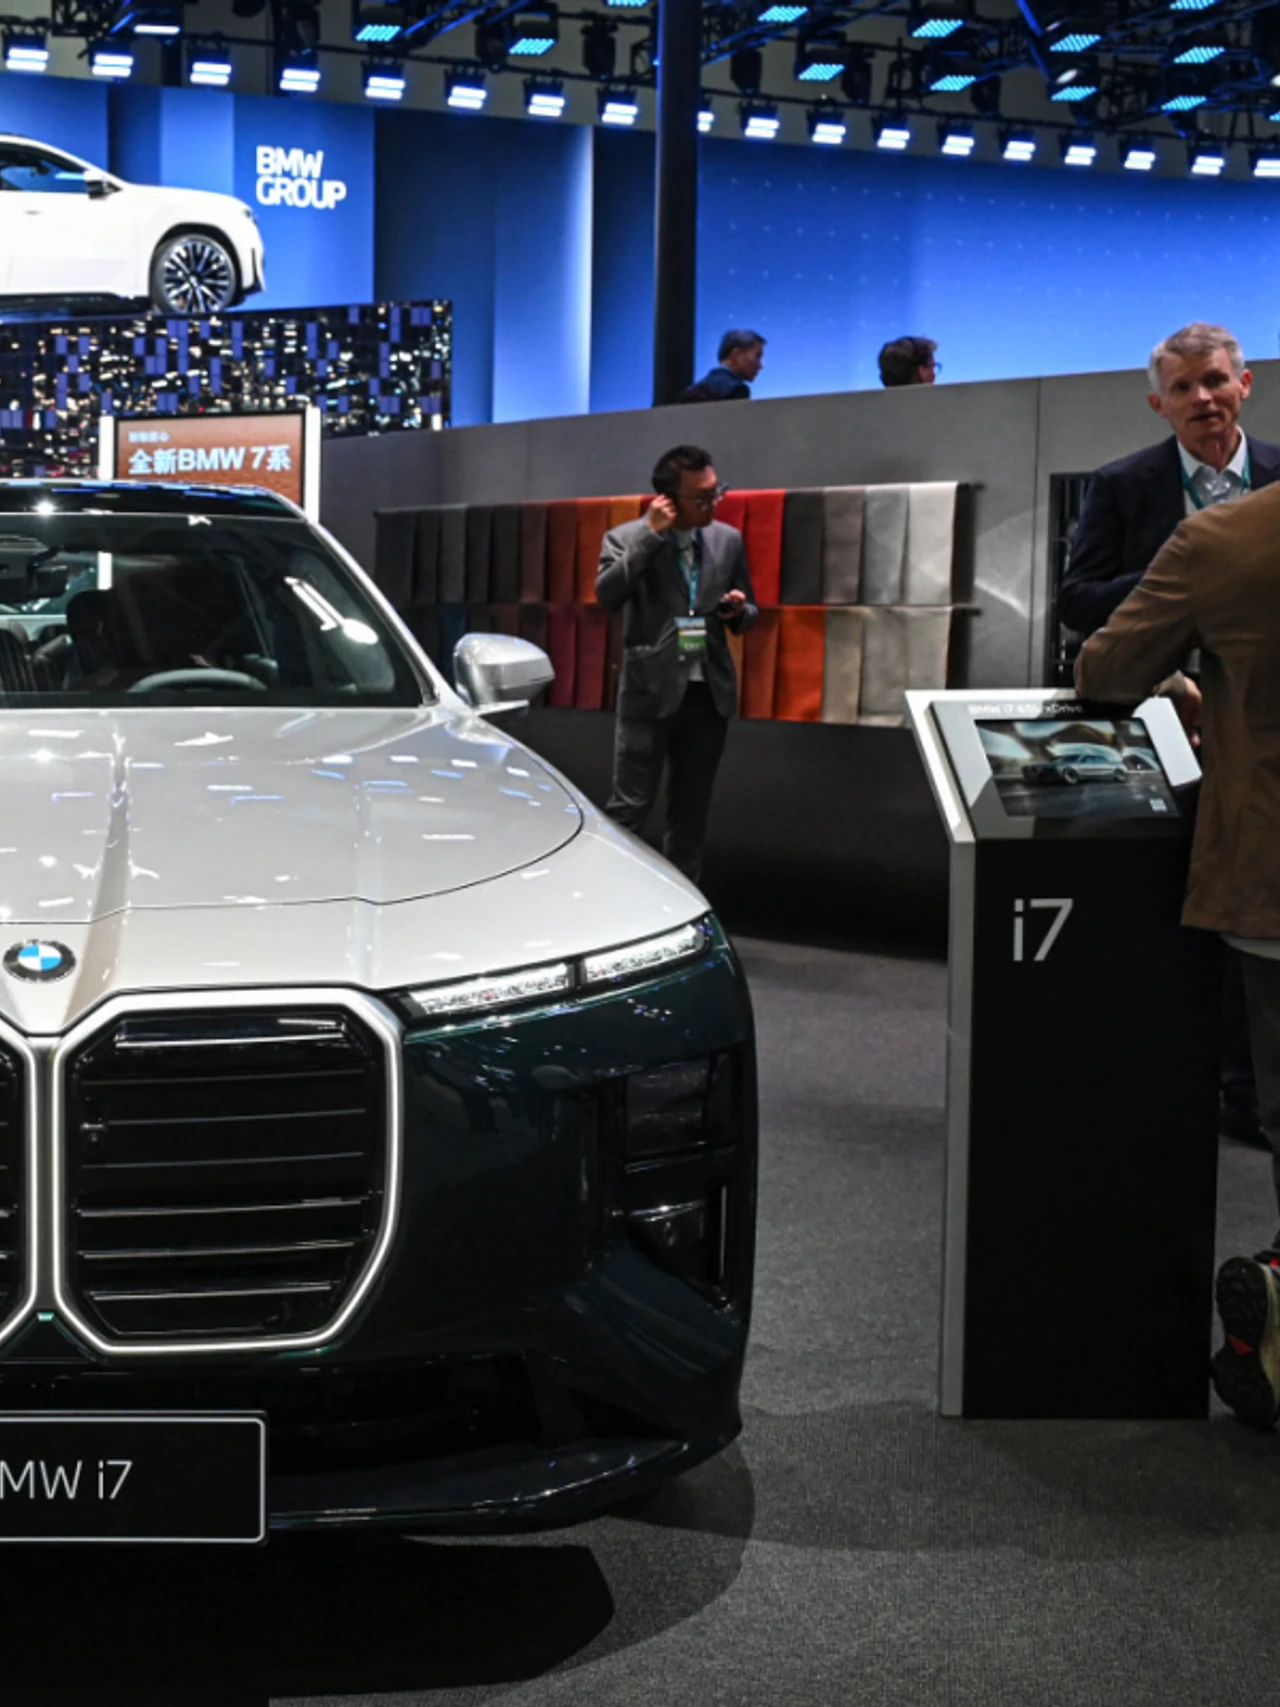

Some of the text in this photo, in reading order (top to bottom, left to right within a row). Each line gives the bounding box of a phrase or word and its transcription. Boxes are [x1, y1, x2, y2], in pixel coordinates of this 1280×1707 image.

[256, 145, 324, 179] BMW
[256, 175, 347, 210] GROUP
[1012, 897, 1074, 962] i7
[97, 1459, 133, 1499] i7
